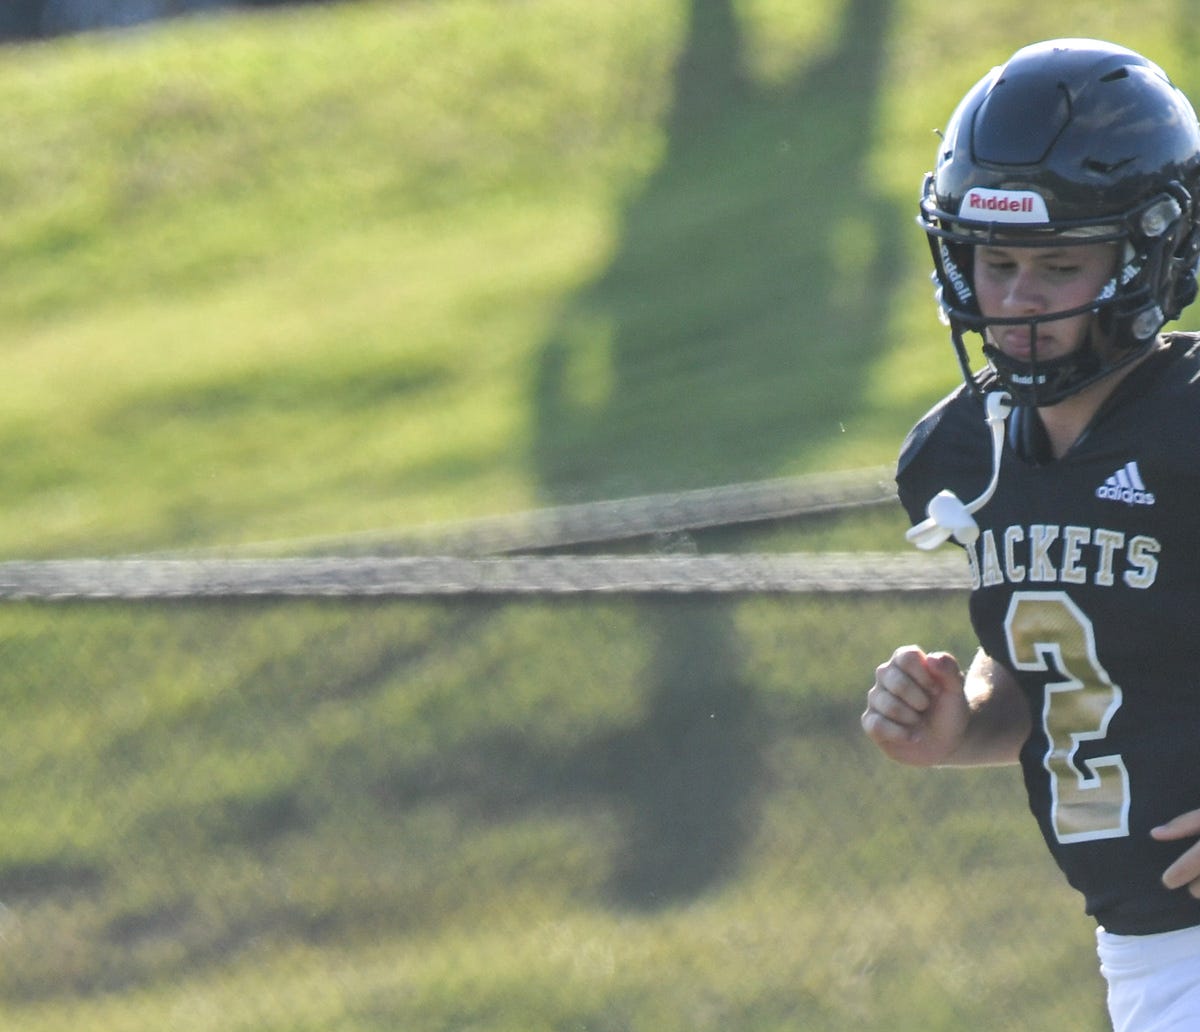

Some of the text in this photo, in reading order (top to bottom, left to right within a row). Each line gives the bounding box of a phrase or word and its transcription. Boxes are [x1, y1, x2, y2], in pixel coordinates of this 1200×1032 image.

[969, 193, 1034, 213] Riddell
[1095, 486, 1156, 506] adidas
[1004, 590, 1131, 844] 2
